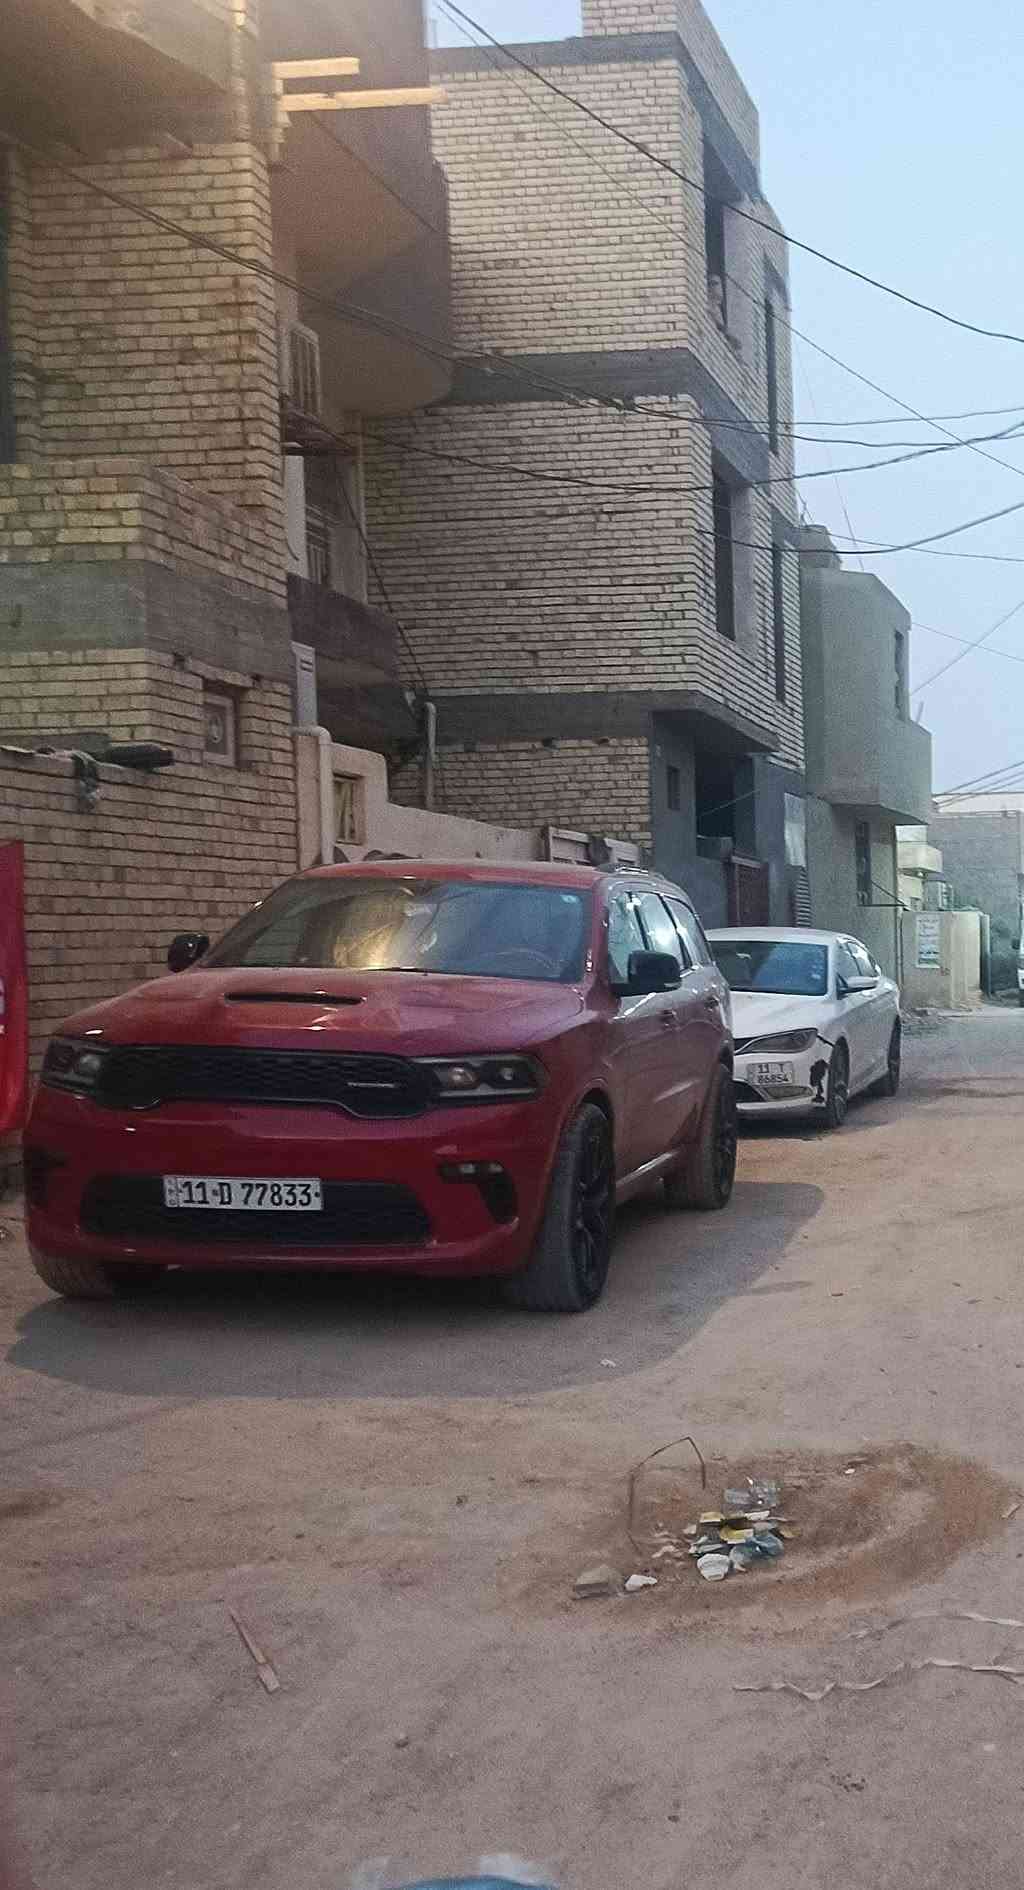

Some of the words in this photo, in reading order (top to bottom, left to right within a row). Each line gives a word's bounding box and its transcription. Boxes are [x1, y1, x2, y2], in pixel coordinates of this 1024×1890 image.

[758, 1063, 770, 1073] 11
[182, 1181, 210, 1204] 11
[219, 1182, 233, 1205] D
[240, 1182, 312, 1206] 77833
